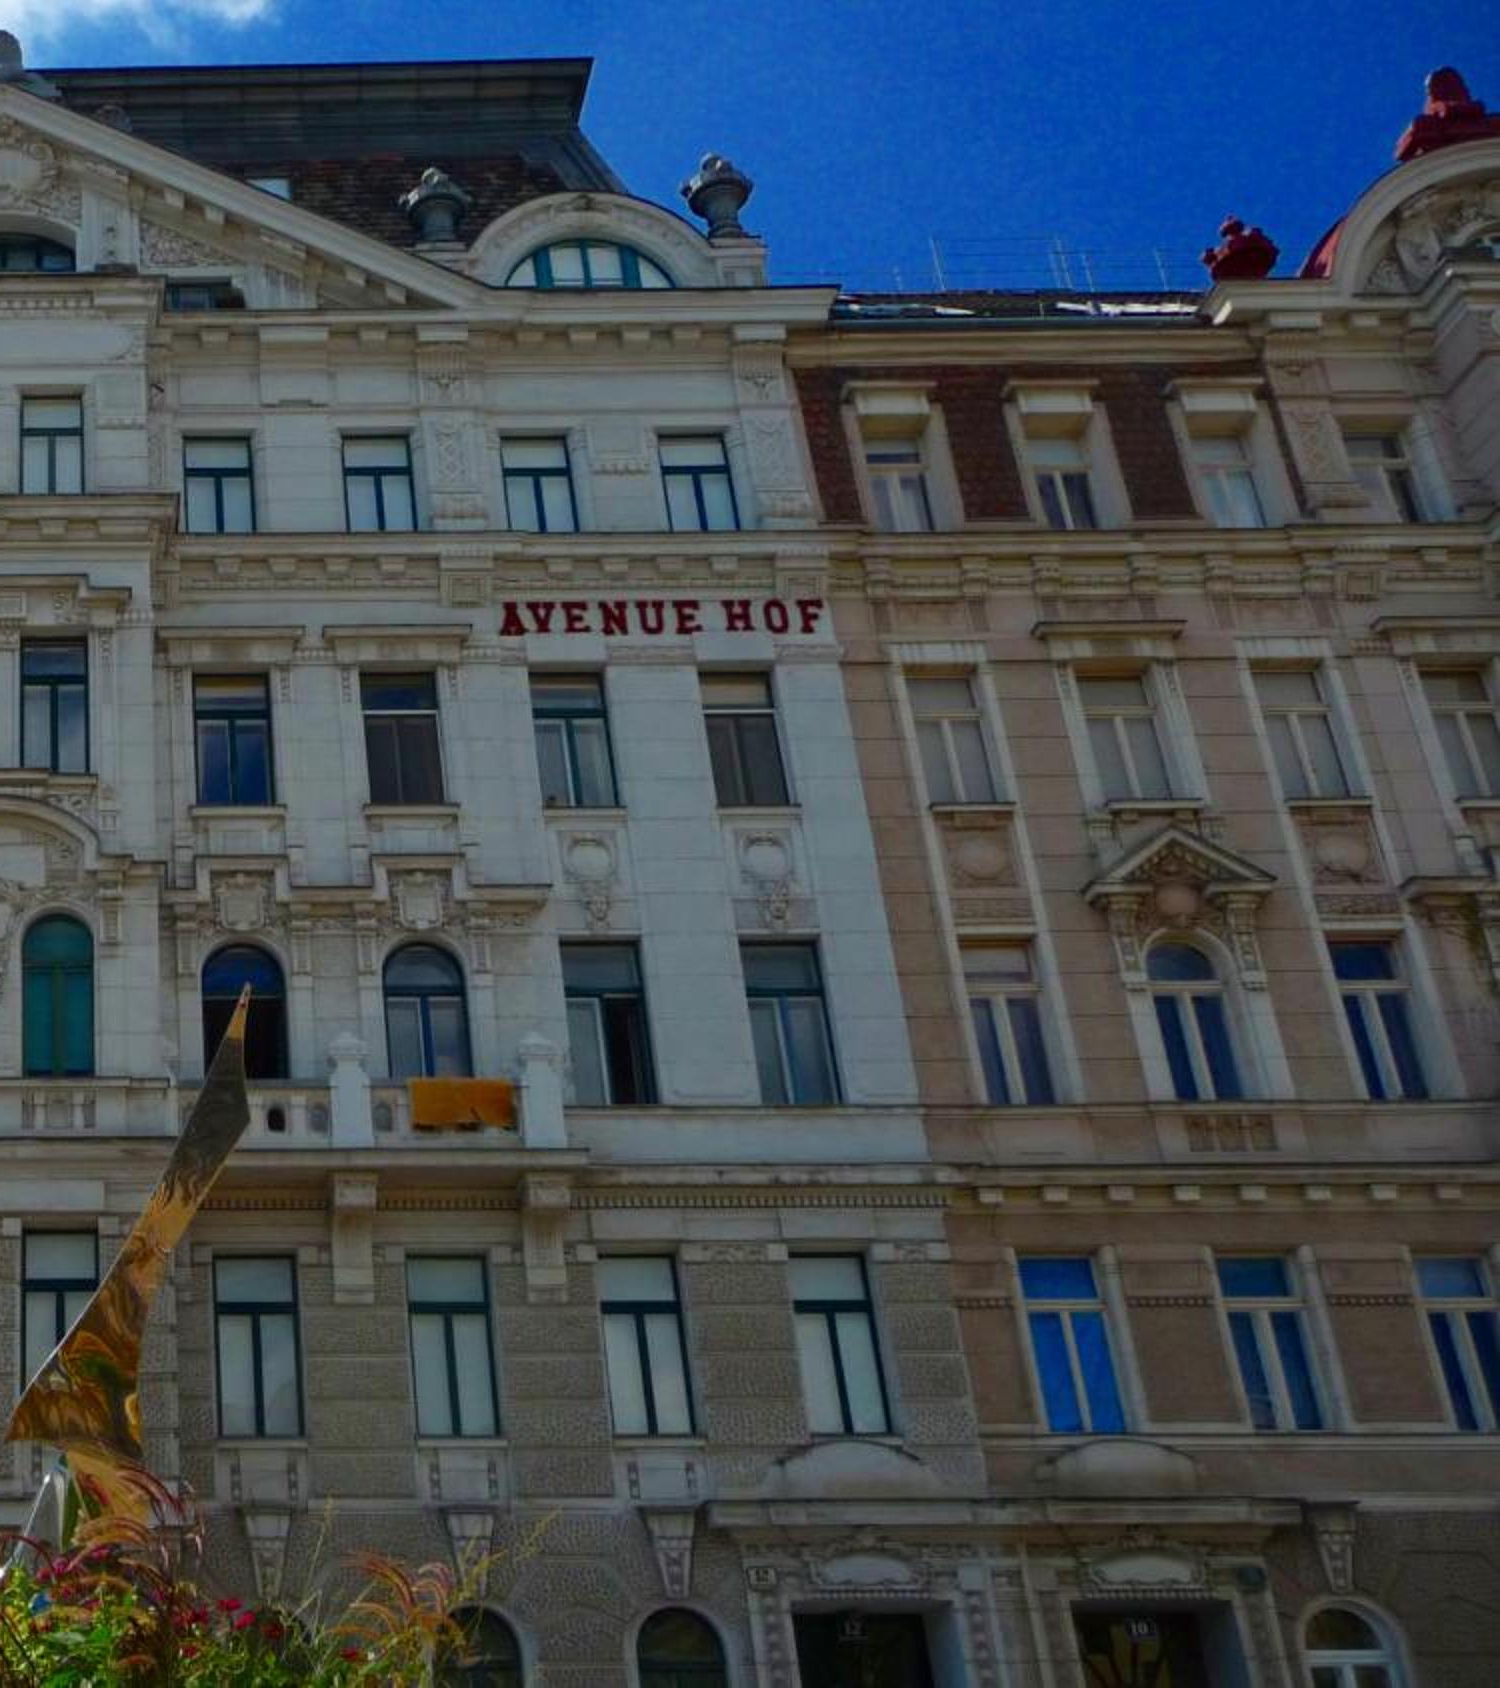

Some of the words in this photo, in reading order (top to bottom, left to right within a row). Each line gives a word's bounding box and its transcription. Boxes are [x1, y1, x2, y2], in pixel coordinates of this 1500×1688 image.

[499, 601, 703, 635] AVENUE
[721, 600, 824, 633] HOF
[1130, 1620, 1150, 1636] 10
